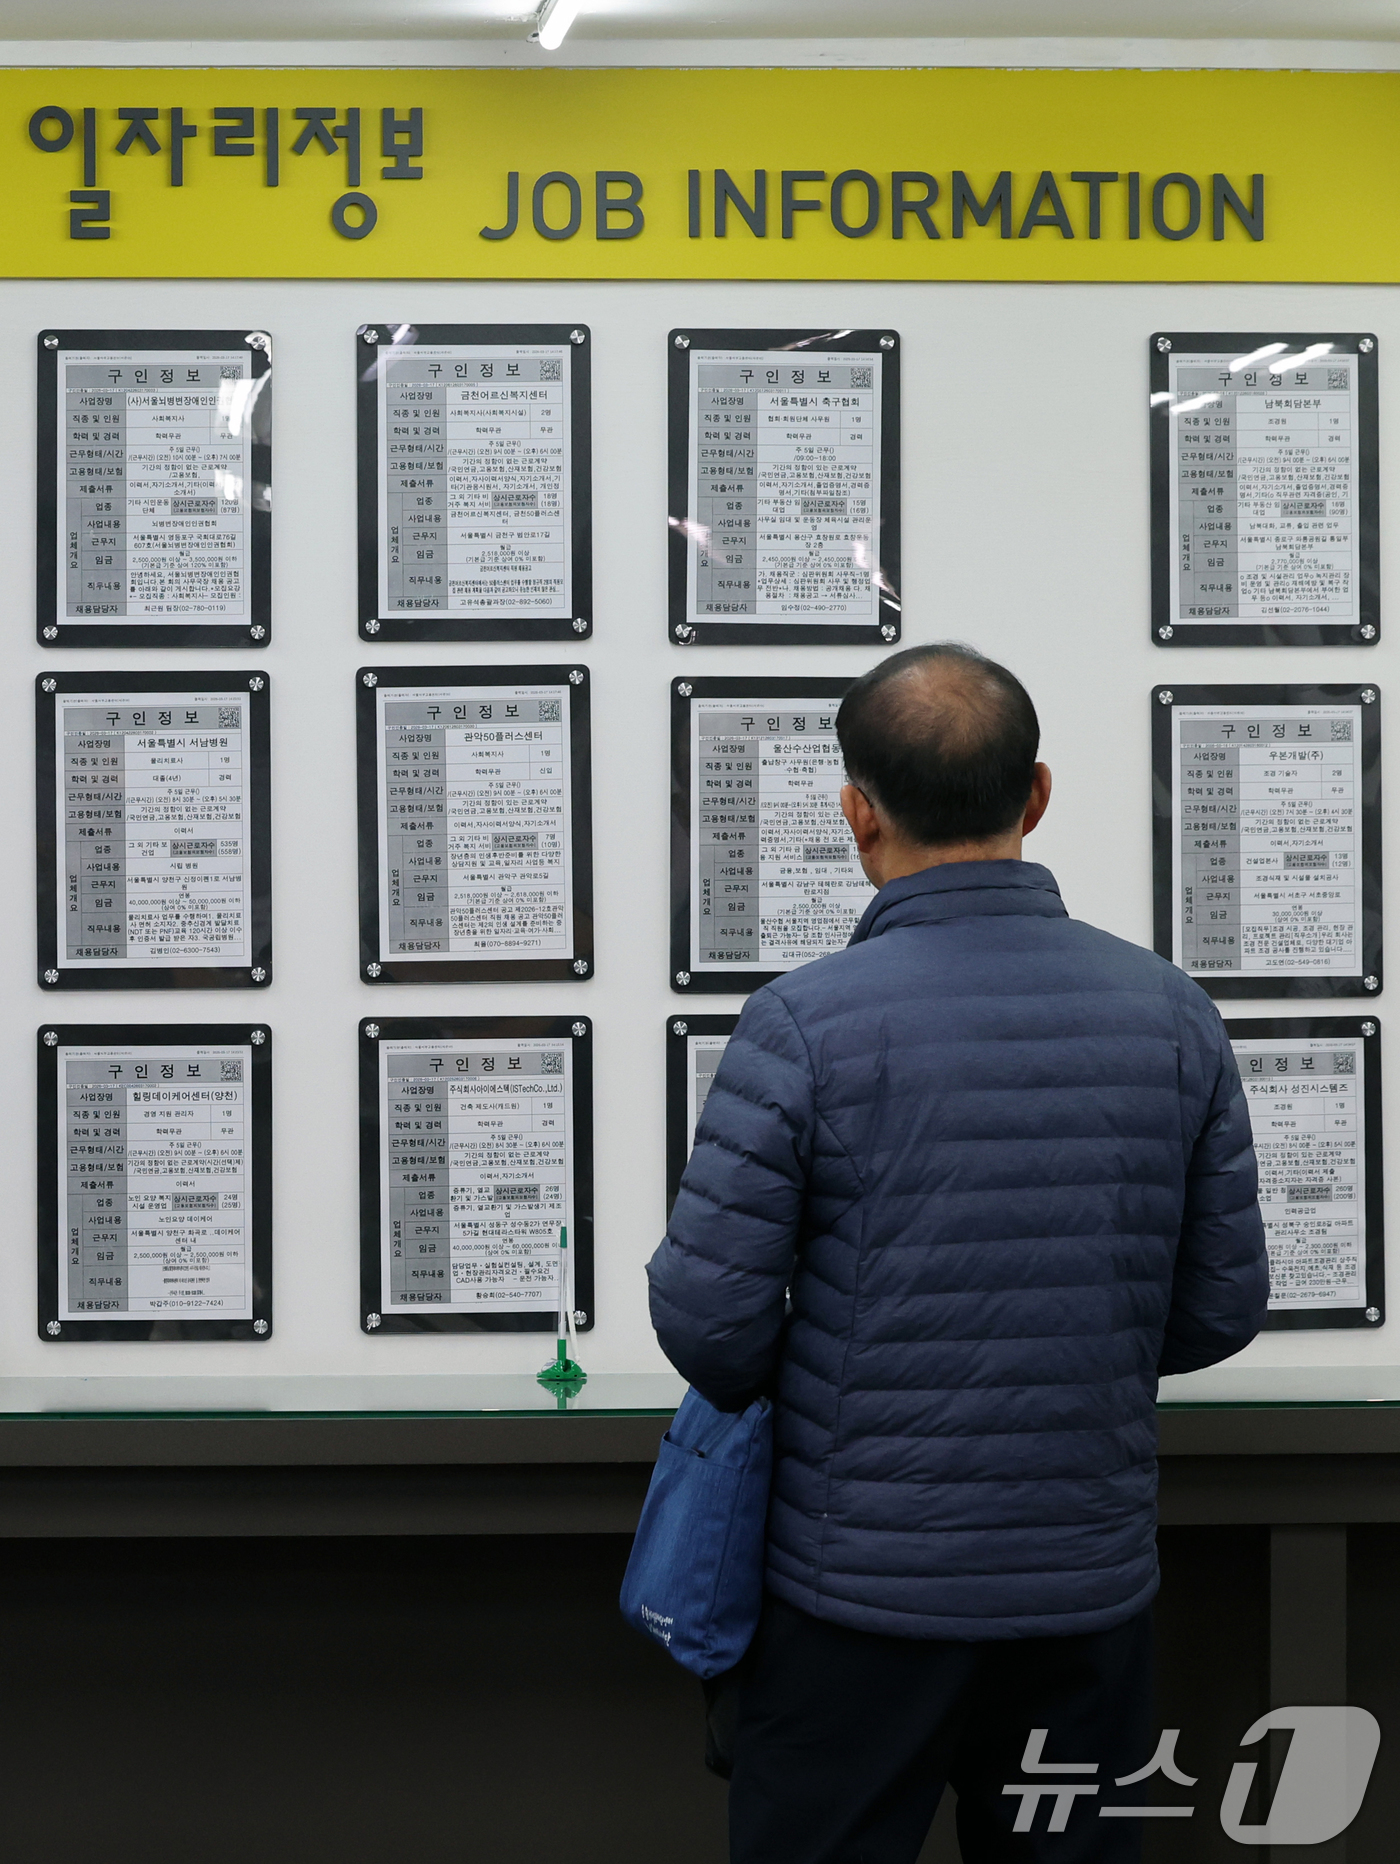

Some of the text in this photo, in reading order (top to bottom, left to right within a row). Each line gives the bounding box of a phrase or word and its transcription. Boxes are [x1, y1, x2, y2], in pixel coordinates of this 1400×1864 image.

[29, 105, 423, 239] 일자리정보
[479, 168, 1265, 241] JOB INFORMATION
[400, 391, 433, 400] 사업장명
[461, 390, 548, 400] 금천어르신복지센터
[80, 397, 113, 405] 사업장명
[711, 397, 744, 405] 사업장명
[770, 397, 860, 406] 서울특별시 축구협회
[1265, 399, 1321, 408] 남북회담본부
[393, 409, 440, 417] 직종 및 인원
[390, 444, 444, 453] 근무형태/시간
[69, 450, 123, 458] 근무형태/시간
[701, 449, 754, 458] 근무형태/시간
[1182, 452, 1234, 461] 근무형태/시간
[390, 461, 443, 470] 고용형태/보험
[69, 468, 123, 476] 고용형태/보험
[701, 466, 753, 475] 고용형태/보험
[1182, 469, 1234, 478] 고용형태/보험
[400, 479, 433, 488] 제출서류
[80, 484, 113, 493] 제출서류
[711, 484, 744, 493] 제출서류
[1192, 487, 1224, 495] 제출서류
[416, 497, 433, 505] 업종
[726, 501, 743, 510] 업종
[96, 503, 112, 511] 업종
[1207, 504, 1223, 513] 업종
[408, 514, 442, 523] 사업내용
[718, 519, 751, 527] 사업내용
[87, 520, 121, 528] 사업내용
[1199, 521, 1232, 530] 사업내용
[412, 532, 437, 540] 근무지
[722, 536, 746, 545] 근무지
[91, 538, 116, 546] 근무지
[1203, 539, 1228, 548] 근무지
[417, 550, 434, 558] 임금
[95, 556, 113, 564] 임금
[726, 555, 743, 563] 임금
[1208, 558, 1224, 566] 임금
[409, 576, 442, 584] 직무내용
[718, 580, 751, 589] 직무내용
[87, 582, 121, 590] 직무내용
[1200, 583, 1233, 592] 직무내용
[397, 599, 439, 607] 채용담당자
[706, 603, 747, 612] 채용담당자
[76, 605, 118, 613] 채용담당자
[1189, 607, 1230, 615] 채용담당자
[399, 734, 432, 742] 사업장명
[464, 731, 543, 741] 관악50플러스센터
[78, 739, 111, 748] 사업장명
[137, 738, 228, 748] 서울특별시 서남병원
[712, 744, 745, 753] 사업장명
[773, 744, 842, 753] 울산수산업협동
[1194, 752, 1226, 760] 사업장명
[1269, 751, 1323, 760] 우본개발(주)
[390, 787, 443, 796] 근무형태/시간
[68, 792, 122, 801] 근무형태/시간
[702, 797, 756, 806] 근무형태/시간
[390, 804, 443, 813] 고용형태/보험
[1184, 805, 1237, 813] 근무형태/시간
[68, 810, 122, 819] 고용형태/보험
[702, 814, 755, 823] 고용형태/보험
[401, 821, 434, 830] 제출서류
[1184, 822, 1237, 831] 고용형태/보험
[79, 827, 112, 836] 제출서류
[712, 832, 746, 840] 제출서류
[417, 839, 433, 848] 업종
[1194, 839, 1227, 848] 제출서류
[95, 845, 111, 854] 업종
[729, 849, 744, 857] 업종
[409, 857, 442, 865] 사업내용
[1210, 857, 1226, 866] 업종
[86, 863, 120, 871] 사업내용
[720, 867, 753, 875] 사업내용
[413, 874, 438, 883] 근무지
[1202, 874, 1235, 883] 사업내용
[91, 880, 116, 889] 근무지
[724, 884, 749, 893] 근무지
[417, 893, 435, 901] 임금
[1206, 892, 1231, 901] 근무지
[95, 898, 112, 907] 임금
[728, 902, 745, 911] 임금
[1210, 910, 1227, 919] 임금
[410, 918, 443, 927] 직무내용
[87, 924, 121, 933] 직무내용
[720, 928, 753, 936] 직무내용
[1203, 936, 1235, 945] 직무내용
[399, 941, 441, 950] 채용담당자
[76, 947, 118, 956] 채용담당자
[709, 951, 750, 959] 채용담당자
[1191, 960, 1232, 968] 채용담당자
[402, 1086, 434, 1094] 사업장명
[1250, 1084, 1348, 1095] 주식회사 성진시스템즈
[80, 1092, 113, 1101] 사업장명
[133, 1091, 237, 1101] 힐링데이케어센터(양천)
[392, 1139, 445, 1147] 근무형태/시간
[70, 1146, 124, 1154] 근무형태/시간
[392, 1156, 445, 1164] 고용형태/보험
[70, 1163, 124, 1172] 고용형태/보험
[402, 1173, 436, 1182] 제출서류
[81, 1181, 114, 1189] 제출서류
[419, 1191, 435, 1199] 업종
[96, 1198, 113, 1207] 업종
[410, 1208, 444, 1217] 사업내용
[88, 1216, 122, 1224] 사업내용
[415, 1225, 440, 1234] 근무지
[93, 1233, 117, 1242] 근무지
[419, 1244, 436, 1252] 임금
[97, 1252, 114, 1260] 임금
[411, 1270, 445, 1278] 직무내용
[89, 1277, 122, 1286] 직무내용
[400, 1293, 442, 1302] 채용담당자
[77, 1300, 119, 1309] 채용담당자
